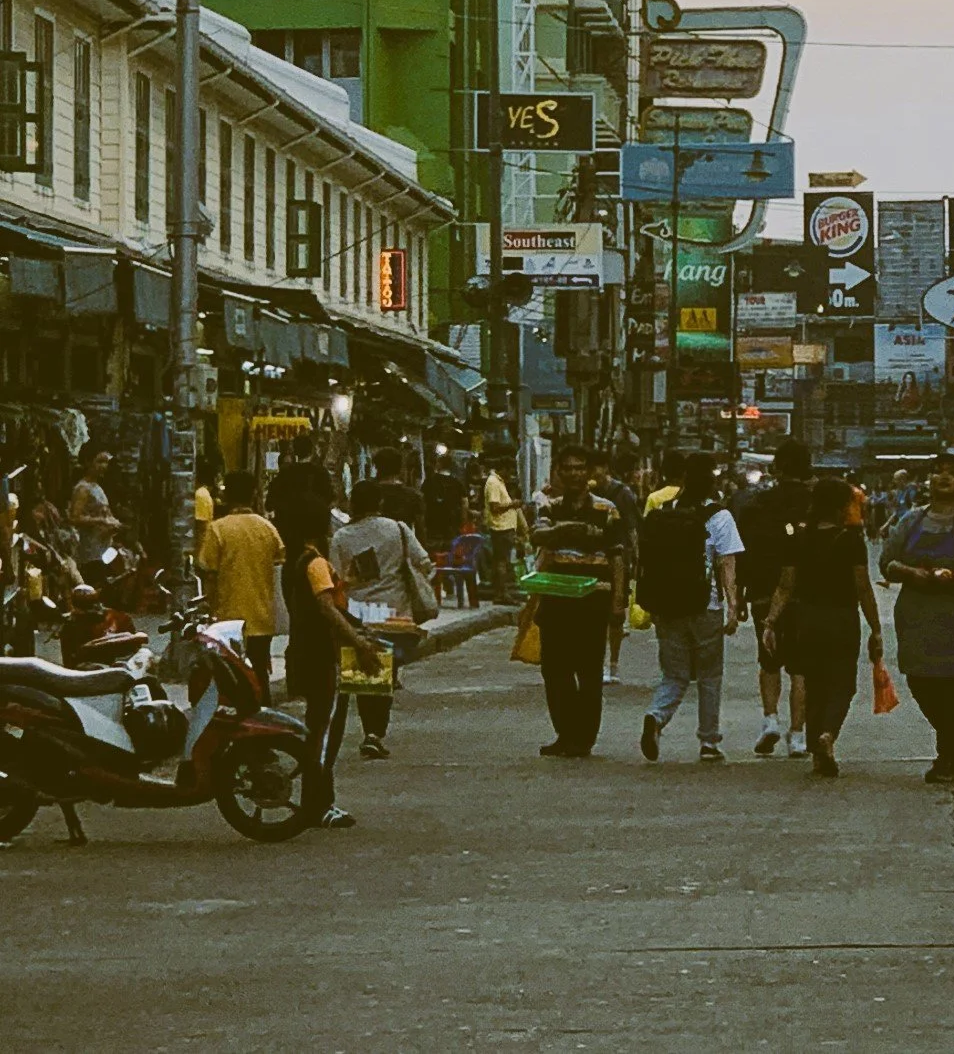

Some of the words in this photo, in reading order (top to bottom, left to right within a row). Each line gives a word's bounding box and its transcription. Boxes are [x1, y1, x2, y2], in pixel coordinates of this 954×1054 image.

[508, 100, 559, 138] YES
[818, 208, 859, 230] BURGER
[503, 233, 576, 248] Southeast
[820, 219, 861, 243] KING
